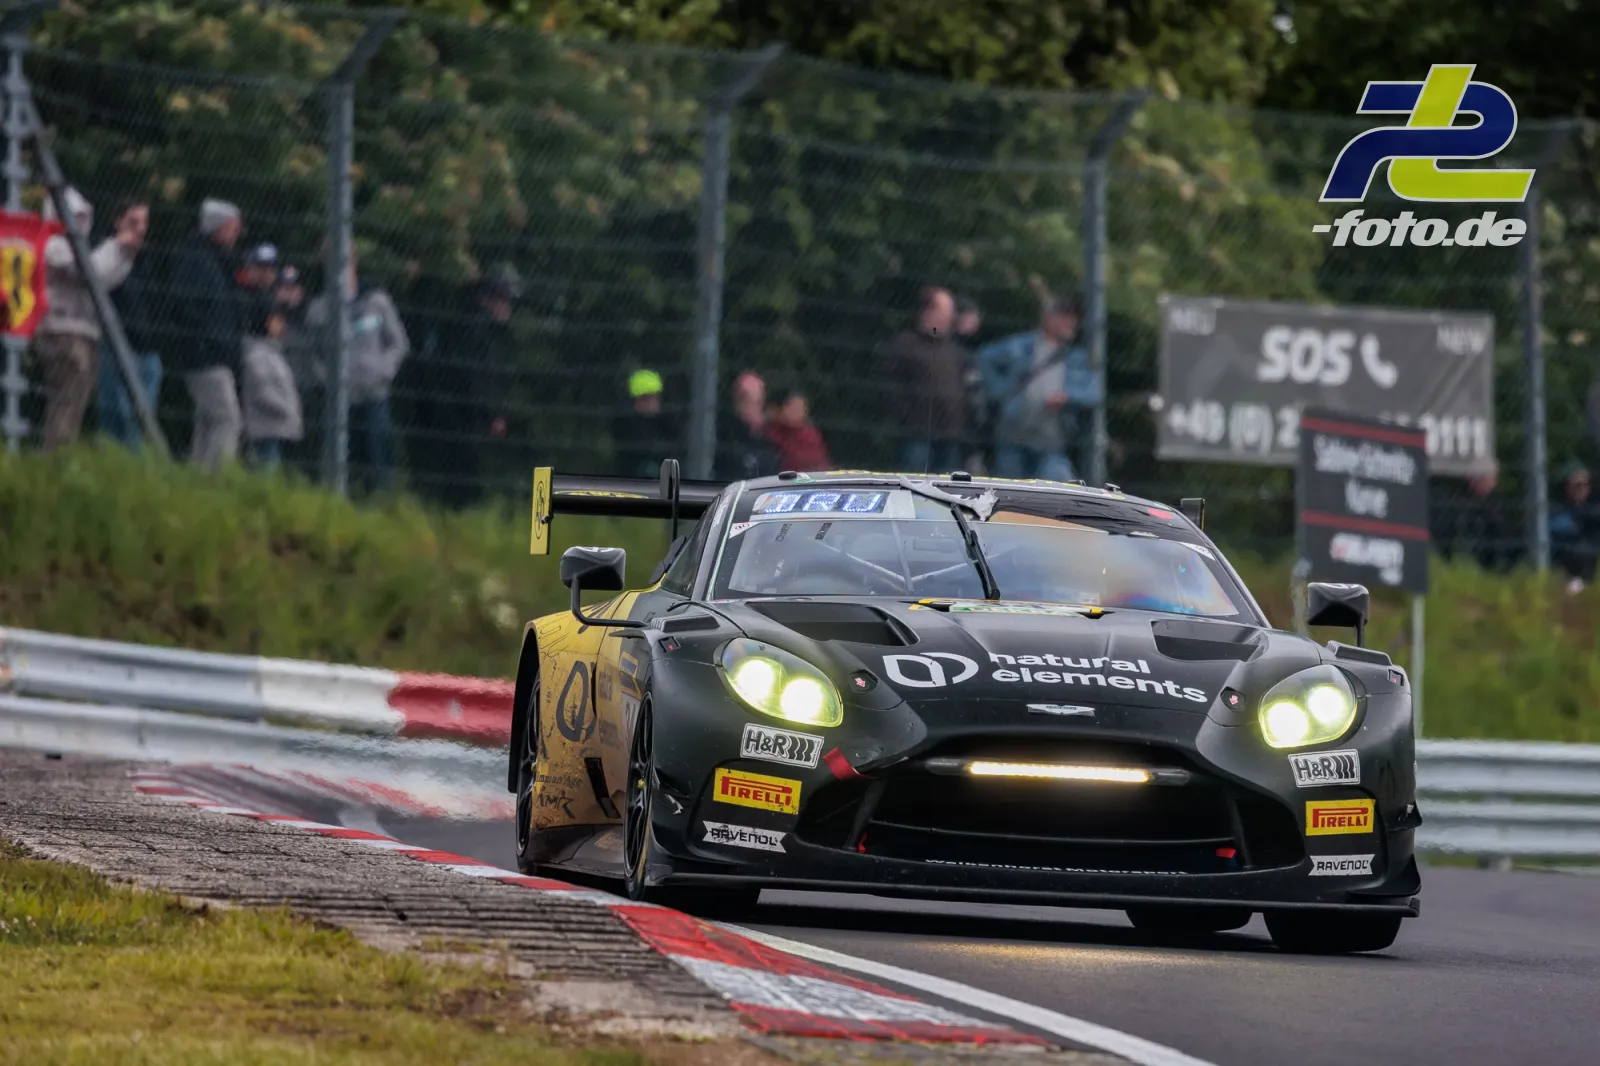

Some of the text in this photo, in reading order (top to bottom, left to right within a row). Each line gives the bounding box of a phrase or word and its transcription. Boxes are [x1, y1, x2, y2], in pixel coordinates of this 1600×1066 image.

[1257, 326, 1355, 386] SOS
[988, 652, 1151, 674] natural
[992, 667, 1208, 703] elements
[720, 776, 793, 806] PIRELLI
[1312, 807, 1369, 829] PIRELLI
[709, 826, 778, 847] RAVENOL
[1316, 859, 1370, 872] RAVENOL
